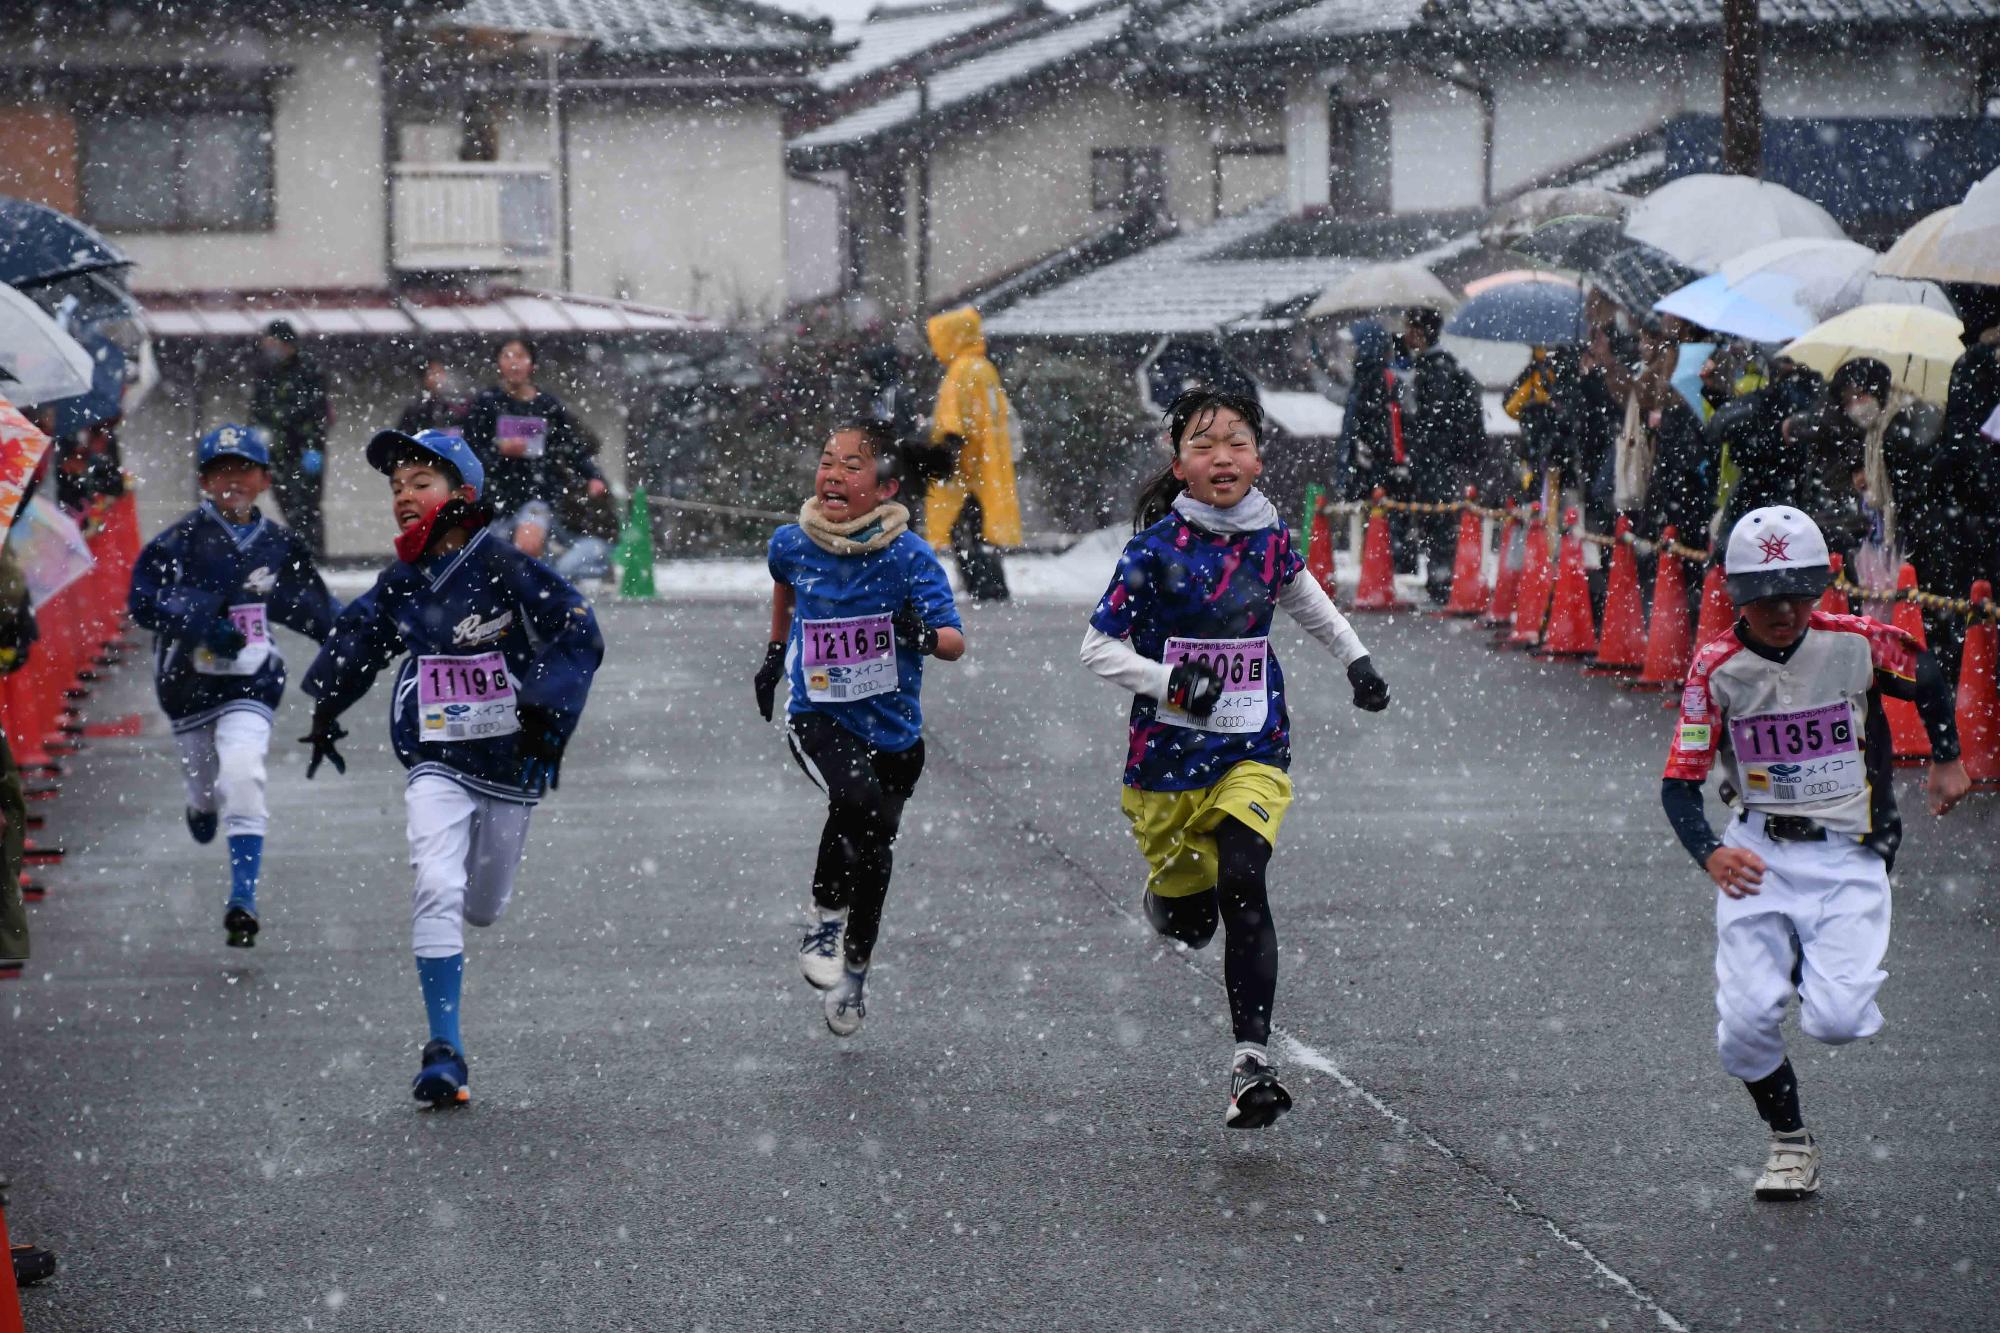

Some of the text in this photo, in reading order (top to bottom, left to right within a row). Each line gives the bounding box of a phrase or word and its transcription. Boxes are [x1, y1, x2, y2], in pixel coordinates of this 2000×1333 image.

[813, 629, 887, 660] 1216 D
[855, 664, 893, 678] メイコー
[1251, 663, 1260, 678] E
[430, 667, 506, 697] 1119 C
[1222, 697, 1263, 708] メイコー
[473, 704, 515, 717] メイコー
[1750, 720, 1848, 755] 1135 C
[1806, 759, 1857, 777] メイコー
[1772, 776, 1802, 784] MEIKO
